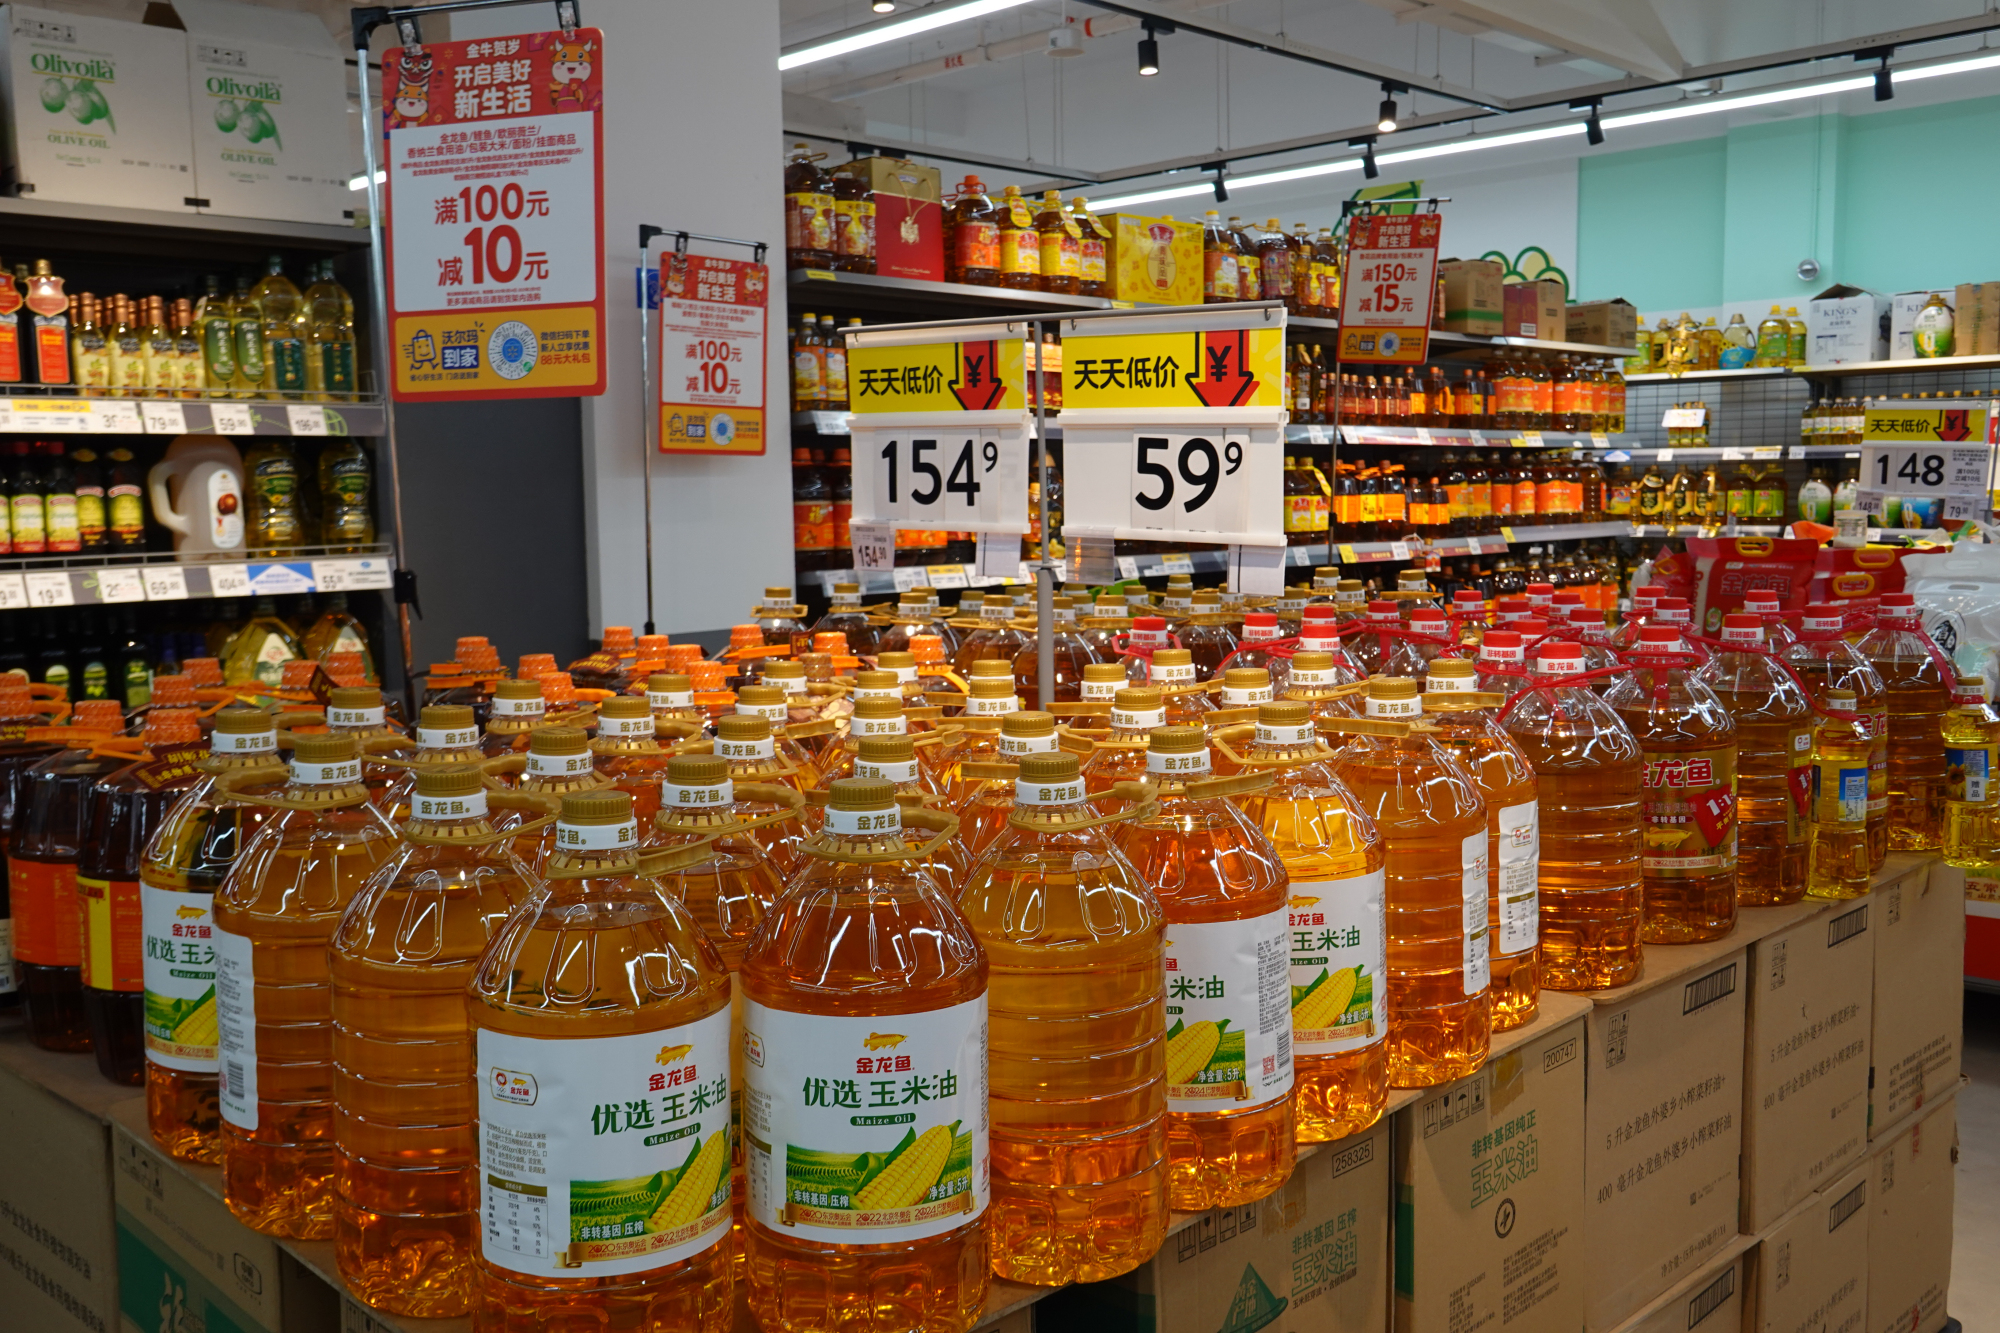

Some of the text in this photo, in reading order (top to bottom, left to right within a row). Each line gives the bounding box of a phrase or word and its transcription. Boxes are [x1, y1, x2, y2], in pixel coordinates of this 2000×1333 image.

[466, 38, 520, 59] 金牛贺岁
[454, 59, 532, 88] 开启美好
[454, 84, 532, 119] 新生活
[47, 134, 111, 149] OLIVE OIL
[220, 152, 278, 166] OLIVE OIL
[434, 182, 550, 225] 满100元
[1378, 235, 1411, 248] 新生活
[437, 224, 549, 287] 减10元
[698, 270, 736, 286] 开启美好
[1361, 263, 1418, 282] 满150元
[697, 284, 736, 302] 新生活
[1358, 284, 1414, 313] 减15元
[1823, 305, 1860, 318] KING'S
[441, 329, 478, 345] 沃尔玛
[442, 348, 478, 369] 到家
[685, 339, 742, 363] 满100元
[540, 353, 591, 366] 88元大礼包
[686, 362, 741, 395] 减10元
[858, 364, 944, 397] 天天低价
[1074, 355, 1180, 390] 天天低价
[1870, 419, 1930, 434] 天天低价
[1877, 452, 1945, 486] 148
[1487, 650, 1516, 658] 非转基因
[1640, 644, 1668, 652] 非转基因
[1166, 668, 1190, 678] 金龙鱼
[1547, 662, 1575, 671] 金龙鱼
[1294, 673, 1319, 682] 金龙鱼
[1428, 680, 1454, 690] 金龙鱼
[1086, 685, 1114, 694] 金龙鱼
[514, 702, 542, 712] 金龙鱼
[757, 708, 786, 718] 金龙鱼
[977, 701, 1008, 712] 金龙鱼
[1378, 703, 1410, 714] 金龙鱼
[333, 712, 366, 722] 金龙鱼
[620, 720, 650, 732] 金龙鱼
[864, 722, 897, 734] 金龙鱼
[235, 736, 271, 748] 金龙鱼
[446, 732, 478, 744] 金龙鱼
[1000, 740, 1027, 752] 金龙鱼
[721, 744, 756, 756] 金龙鱼
[1164, 756, 1202, 770] 金龙鱼
[321, 765, 358, 780] 金龙鱼
[679, 790, 720, 803] 金龙鱼
[1038, 786, 1078, 802] 金龙鱼
[1970, 780, 1980, 798] 赠品
[421, 800, 464, 815] 金龙鱼
[857, 813, 899, 830] 金龙鱼
[1651, 816, 1686, 824] 非转基因
[556, 830, 579, 844] 龙鱼
[1288, 913, 1324, 927] 金龙鱼
[172, 924, 212, 939] 金龙鱼
[1292, 925, 1360, 952] 玉米油
[146, 935, 178, 963] 优选
[172, 970, 196, 979] Maize
[1166, 974, 1224, 1000] 米油
[1339, 1008, 1370, 1024] 净含量:5升
[1546, 1043, 1574, 1068] 200747
[856, 1055, 912, 1074] 金龙鱼
[648, 1064, 698, 1092] 金龙鱼
[1198, 1066, 1240, 1084] 净含量:5升
[510, 1086, 530, 1096] 金龙鱼
[802, 1076, 862, 1109] 优选
[868, 1069, 958, 1108] 玉米油
[590, 1098, 655, 1136] 优选
[660, 1073, 727, 1126] 玉米油
[856, 1114, 912, 1125] Maize Oil
[649, 1124, 698, 1146] Maize Oil
[1471, 1109, 1537, 1159] 非转基因纯正
[1334, 1143, 1371, 1173] 258325
[1470, 1134, 1538, 1210] 玉米油
[929, 1178, 968, 1200] 净含量:5升
[794, 1190, 849, 1208] 非转基因 压榨
[800, 1208, 852, 1220] 2020东京奥运会
[856, 1210, 911, 1222] 2022北京冬奥会
[914, 1199, 960, 1218] 2024巴黎奥运会
[580, 1220, 644, 1240] 非转基因 压榨
[650, 1222, 698, 1245] 2022北京冬奥会
[1292, 1208, 1357, 1255] 非转基因 压榨
[588, 1238, 646, 1254] 2020东京奥运会
[1291, 1231, 1358, 1298] 玉米油
